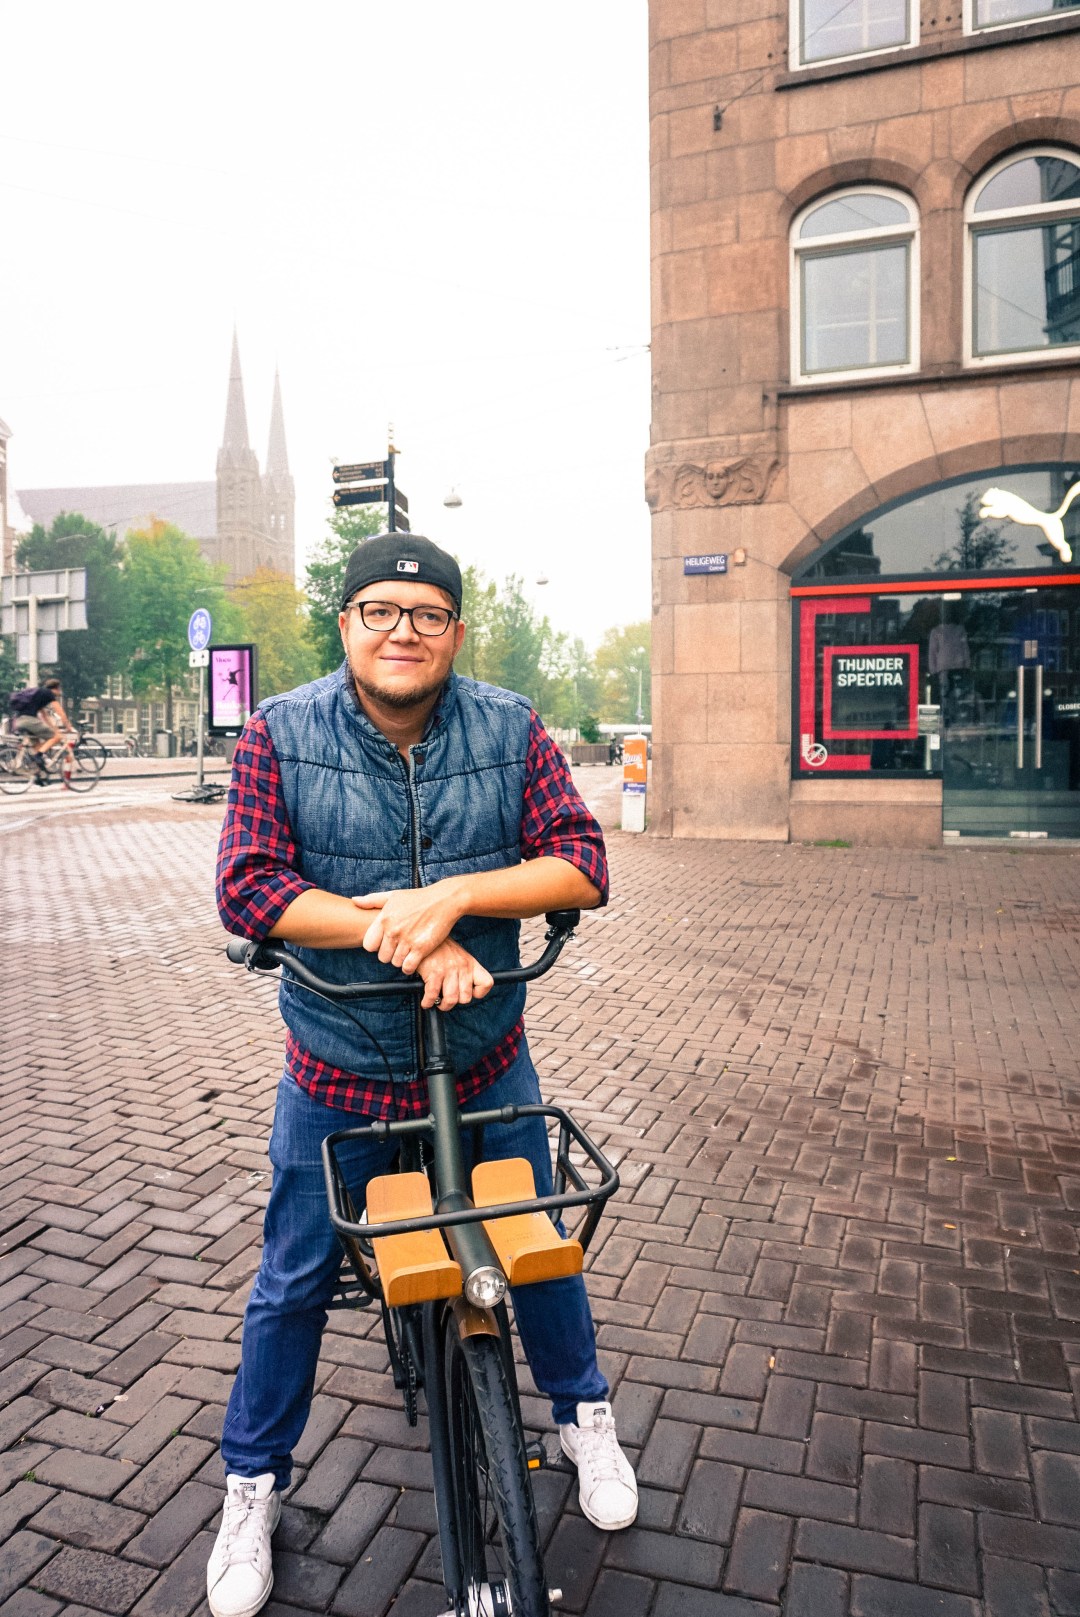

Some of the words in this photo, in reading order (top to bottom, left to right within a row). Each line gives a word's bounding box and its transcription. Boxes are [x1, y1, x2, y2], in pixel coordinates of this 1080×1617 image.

[685, 556, 725, 566] HEILIGEWEG
[838, 658, 903, 671] THUNDER
[837, 672, 903, 687] SPECTRA
